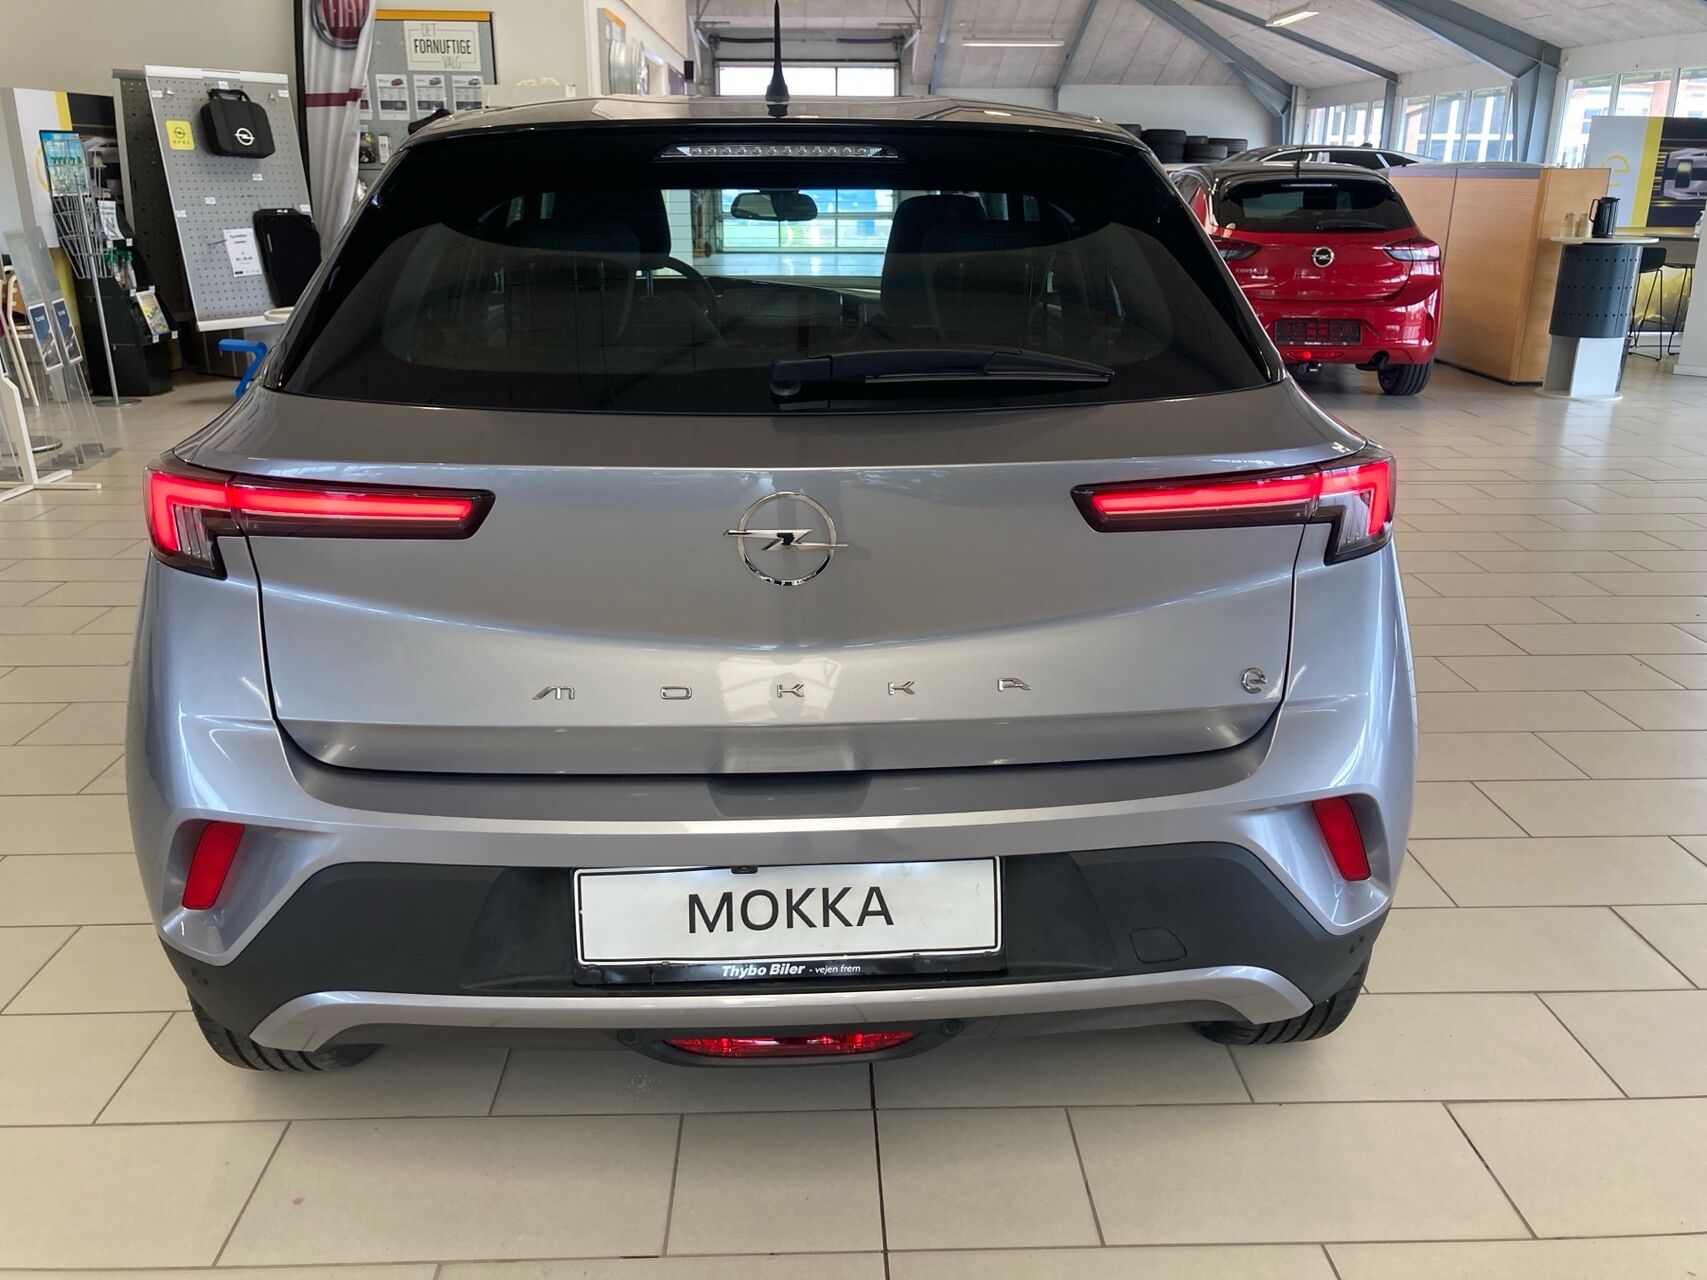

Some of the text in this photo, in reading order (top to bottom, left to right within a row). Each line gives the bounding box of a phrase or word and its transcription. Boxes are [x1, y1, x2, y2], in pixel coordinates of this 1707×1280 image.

[421, 23, 436, 36] DET
[414, 39, 472, 54] FORNUFTIGE
[442, 56, 462, 69] VALG
[532, 678, 1032, 701] MOKKA
[688, 886, 894, 934] MOKKA
[722, 964, 766, 978] Thybo
[770, 963, 805, 975] Biler
[815, 966, 838, 976] vejen
[840, 964, 861, 974] frem
